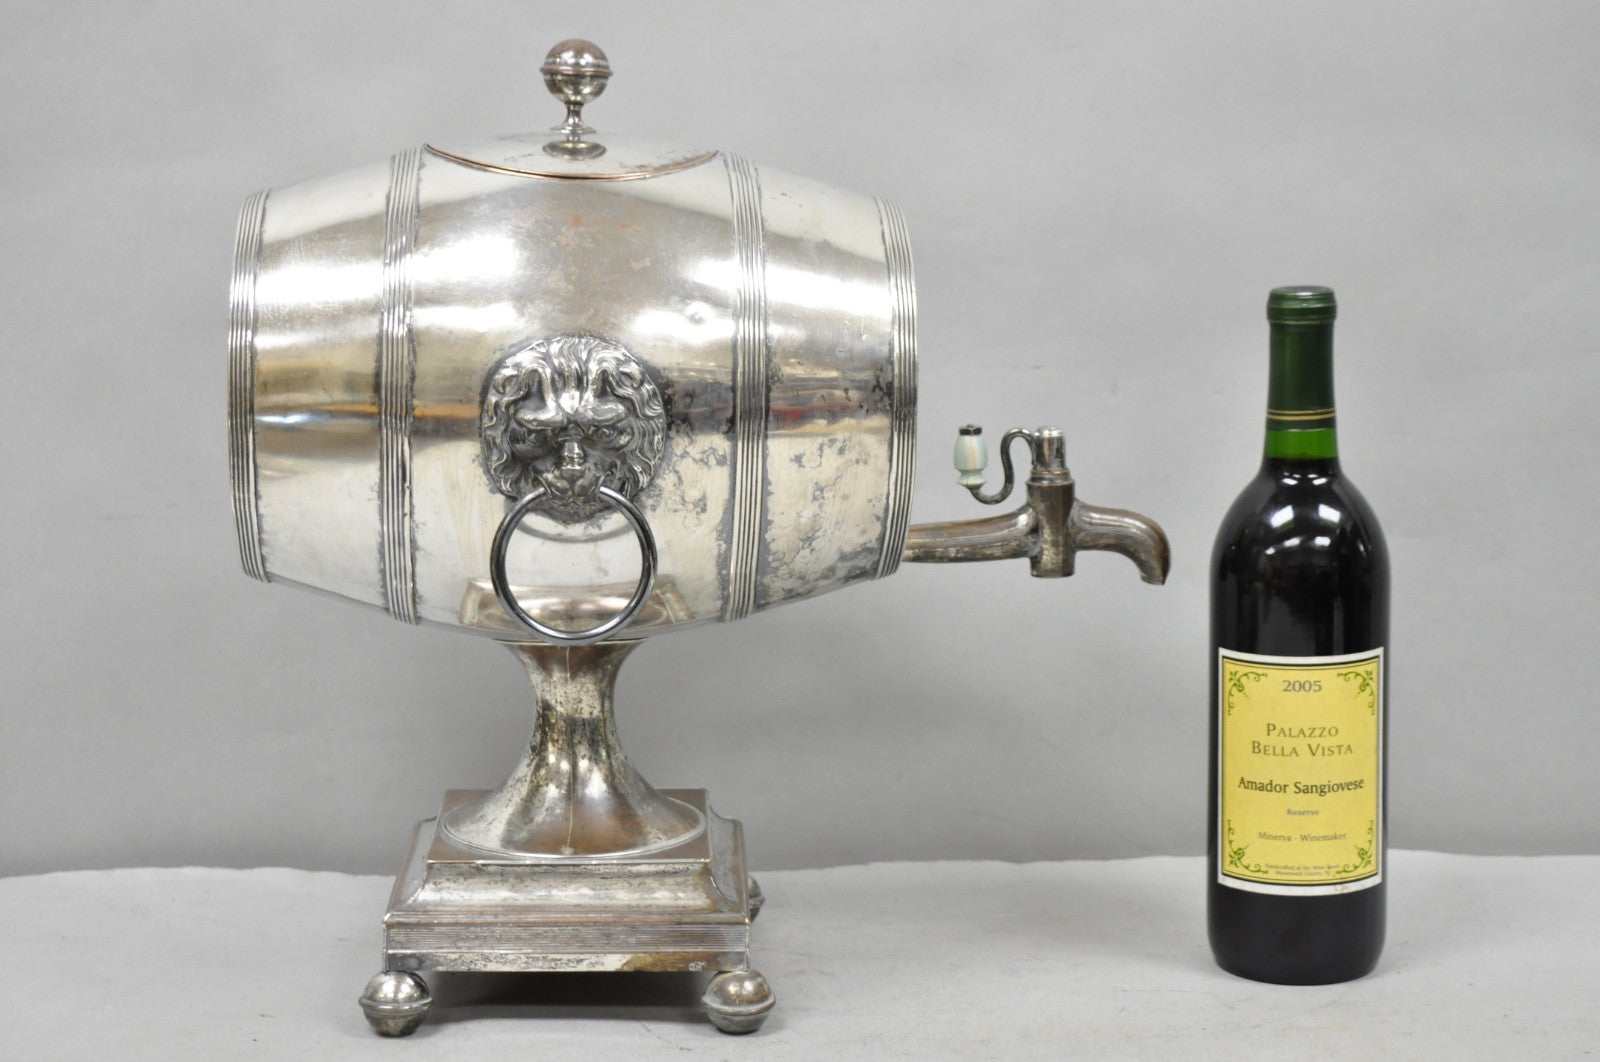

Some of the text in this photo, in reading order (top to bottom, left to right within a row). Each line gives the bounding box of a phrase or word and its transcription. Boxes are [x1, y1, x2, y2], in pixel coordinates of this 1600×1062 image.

[1282, 680, 1322, 692] 2005
[1266, 723, 1339, 738] PALAZZO
[1252, 740, 1353, 757] BELLA VISTA
[1238, 776, 1364, 796] Amador Sangiovese
[1286, 808, 1320, 816] Reserve
[1258, 831, 1347, 842] Minerva Winemaker
